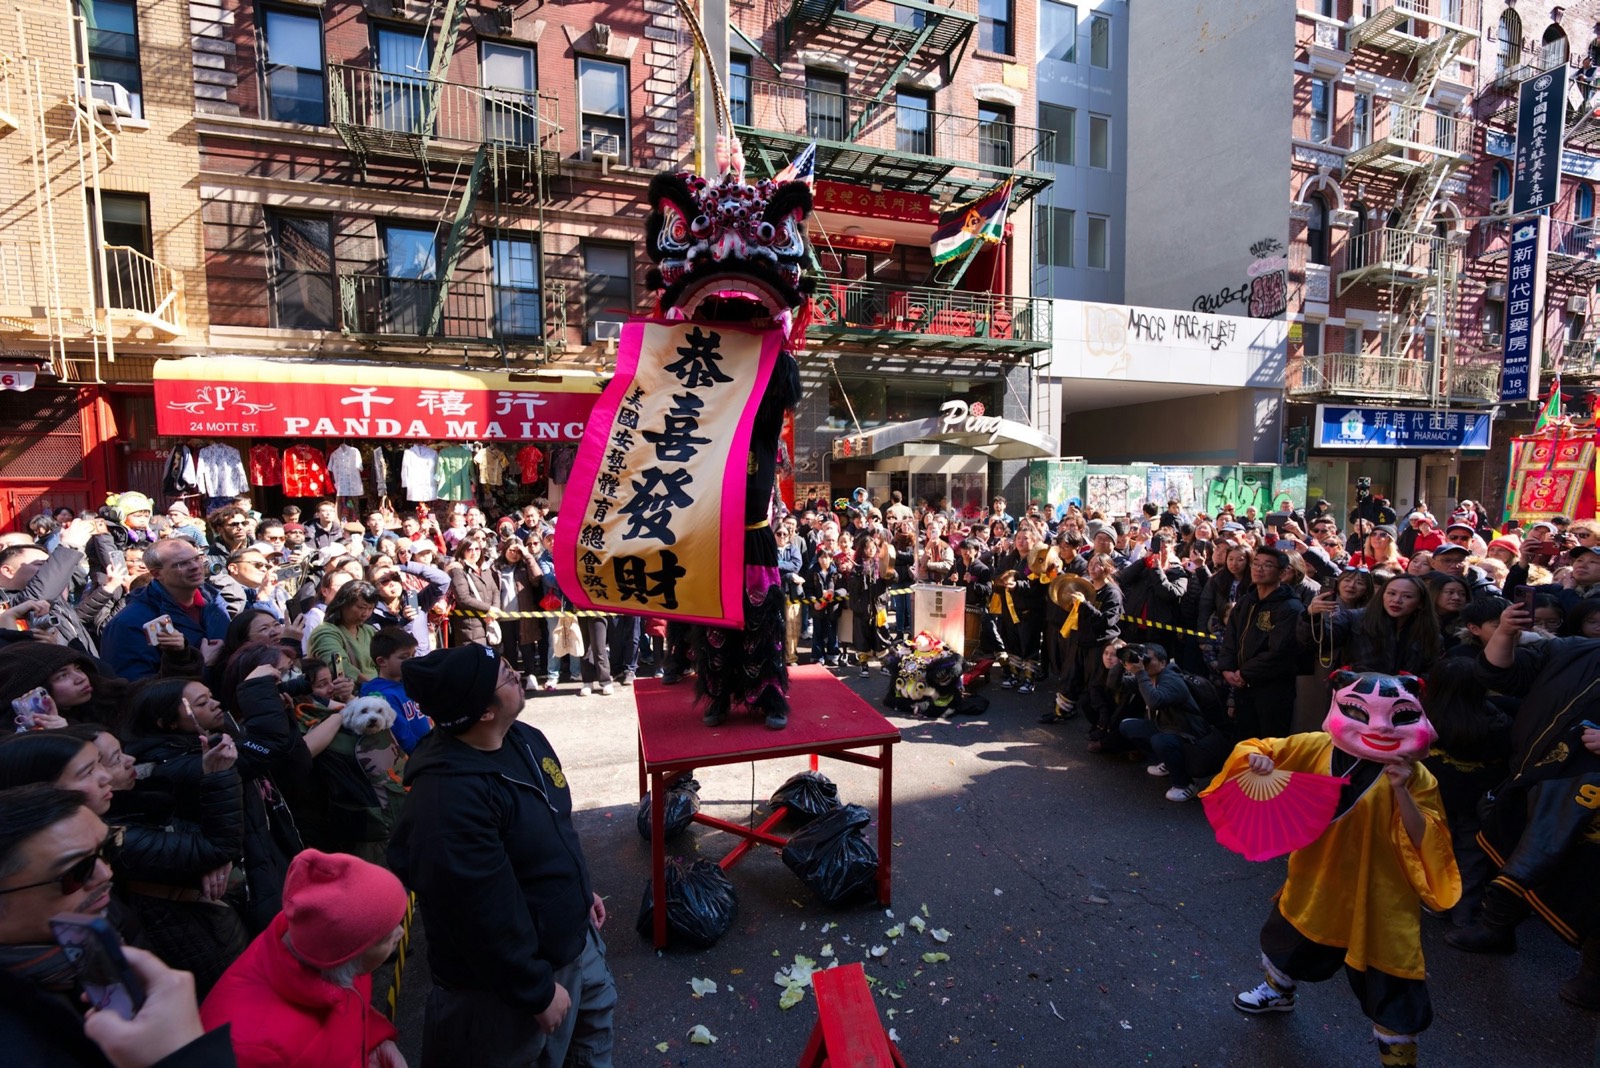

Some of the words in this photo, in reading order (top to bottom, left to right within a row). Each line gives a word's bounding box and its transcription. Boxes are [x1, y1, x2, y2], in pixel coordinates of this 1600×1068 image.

[1507, 246, 1533, 352] 新時代西藥房
[1503, 364, 1529, 375] PHARMACY
[1509, 380, 1522, 388] 18
[340, 387, 548, 420] 千禧行
[190, 422, 203, 431] 24
[207, 422, 239, 432] MOTT
[242, 423, 258, 432] ST.
[284, 417, 431, 437] PANDA
[445, 421, 507, 438] MA
[939, 400, 1003, 444] Ping
[1374, 412, 1476, 431] 新時代西藥房
[1414, 431, 1450, 441] PHARMACY
[613, 326, 734, 610] 恭喜發財
[800, 459, 818, 473] 22
[243, 740, 270, 755] SONY
